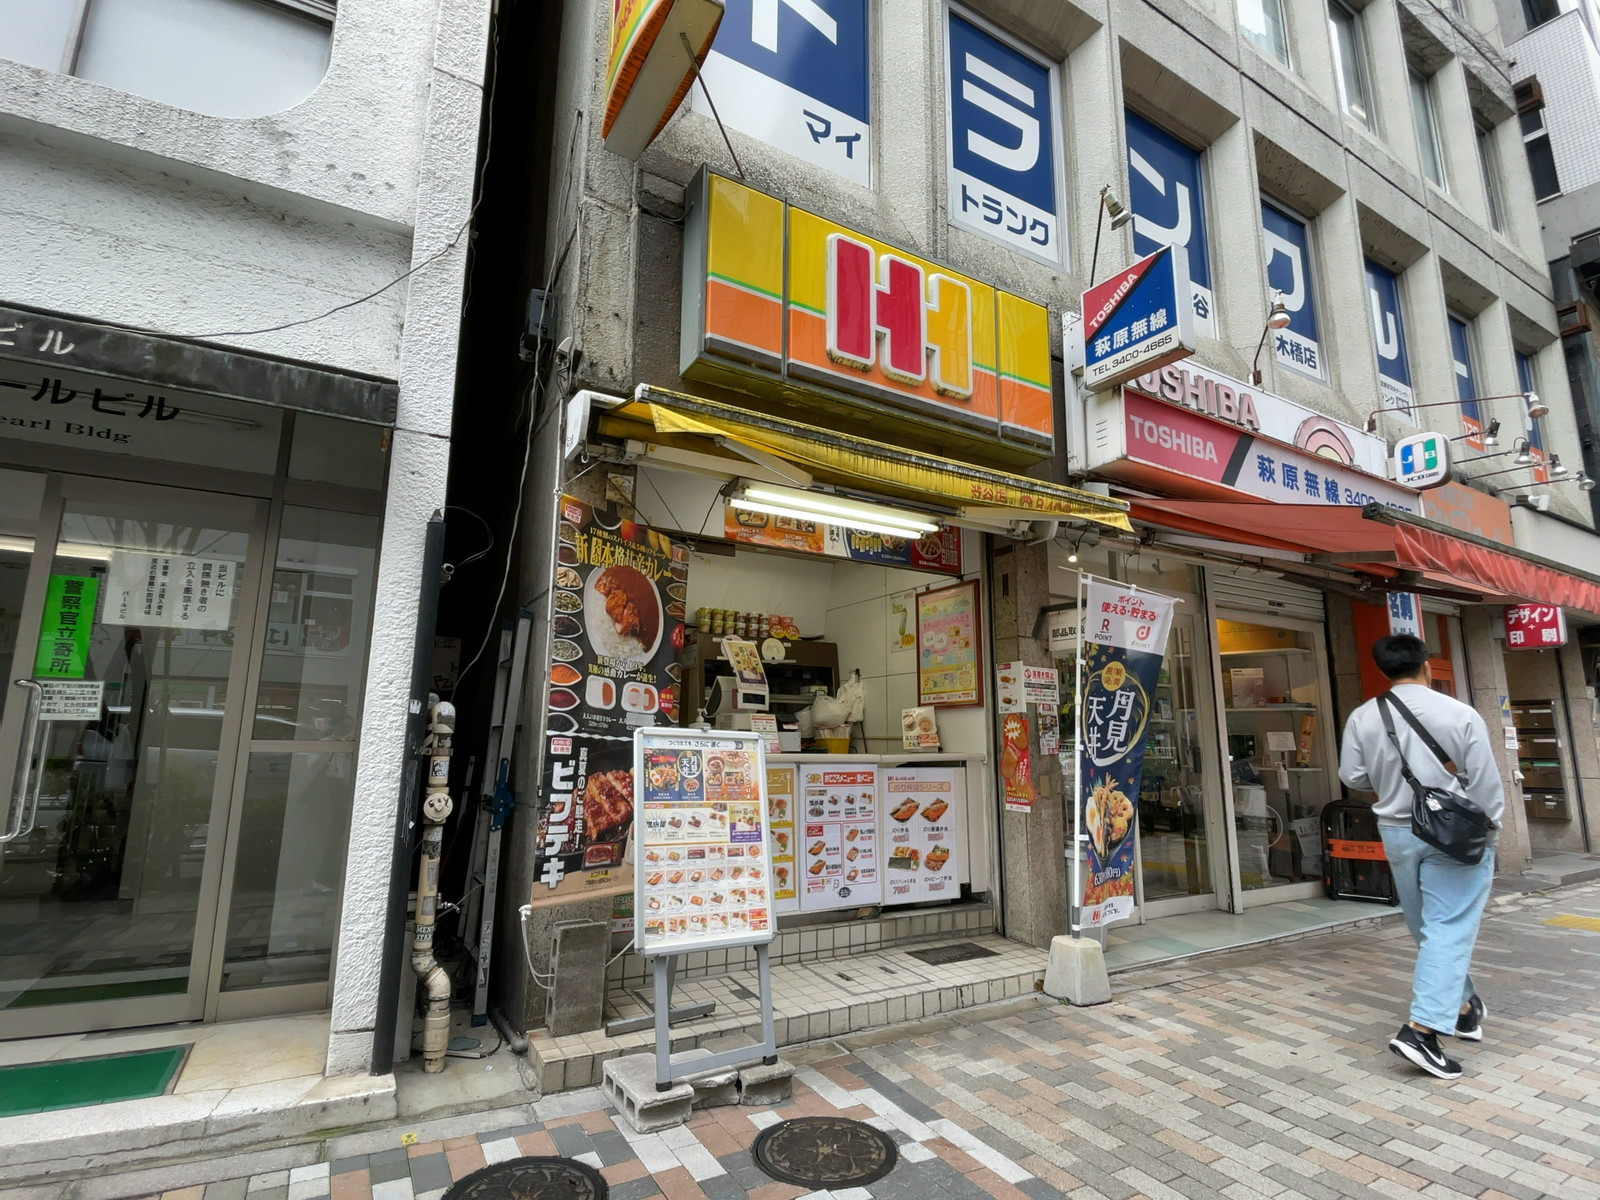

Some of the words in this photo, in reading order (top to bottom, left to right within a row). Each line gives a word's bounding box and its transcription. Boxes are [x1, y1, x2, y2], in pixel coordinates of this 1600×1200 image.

[803, 109, 862, 160] マイ
[961, 184, 1050, 247] トランク
[1089, 272, 1139, 328] TOSHIBA
[1091, 363, 1111, 377] TEL
[1112, 334, 1173, 369] 3400-4665
[1094, 308, 1169, 358] 萩原無線
[1137, 364, 1261, 431] OSHIBA
[1129, 414, 1219, 465] TOSHIBA
[1256, 454, 1341, 504] 萩原無線
[1403, 474, 1425, 483] JCB
[49, 579, 85, 674] 警察官立寄所
[1101, 601, 1157, 622] 使える・貯まる
[1117, 595, 1145, 608] ポイント
[1507, 606, 1555, 625] デザイン
[1094, 633, 1113, 642] POINT
[1101, 689, 1136, 753] 月見
